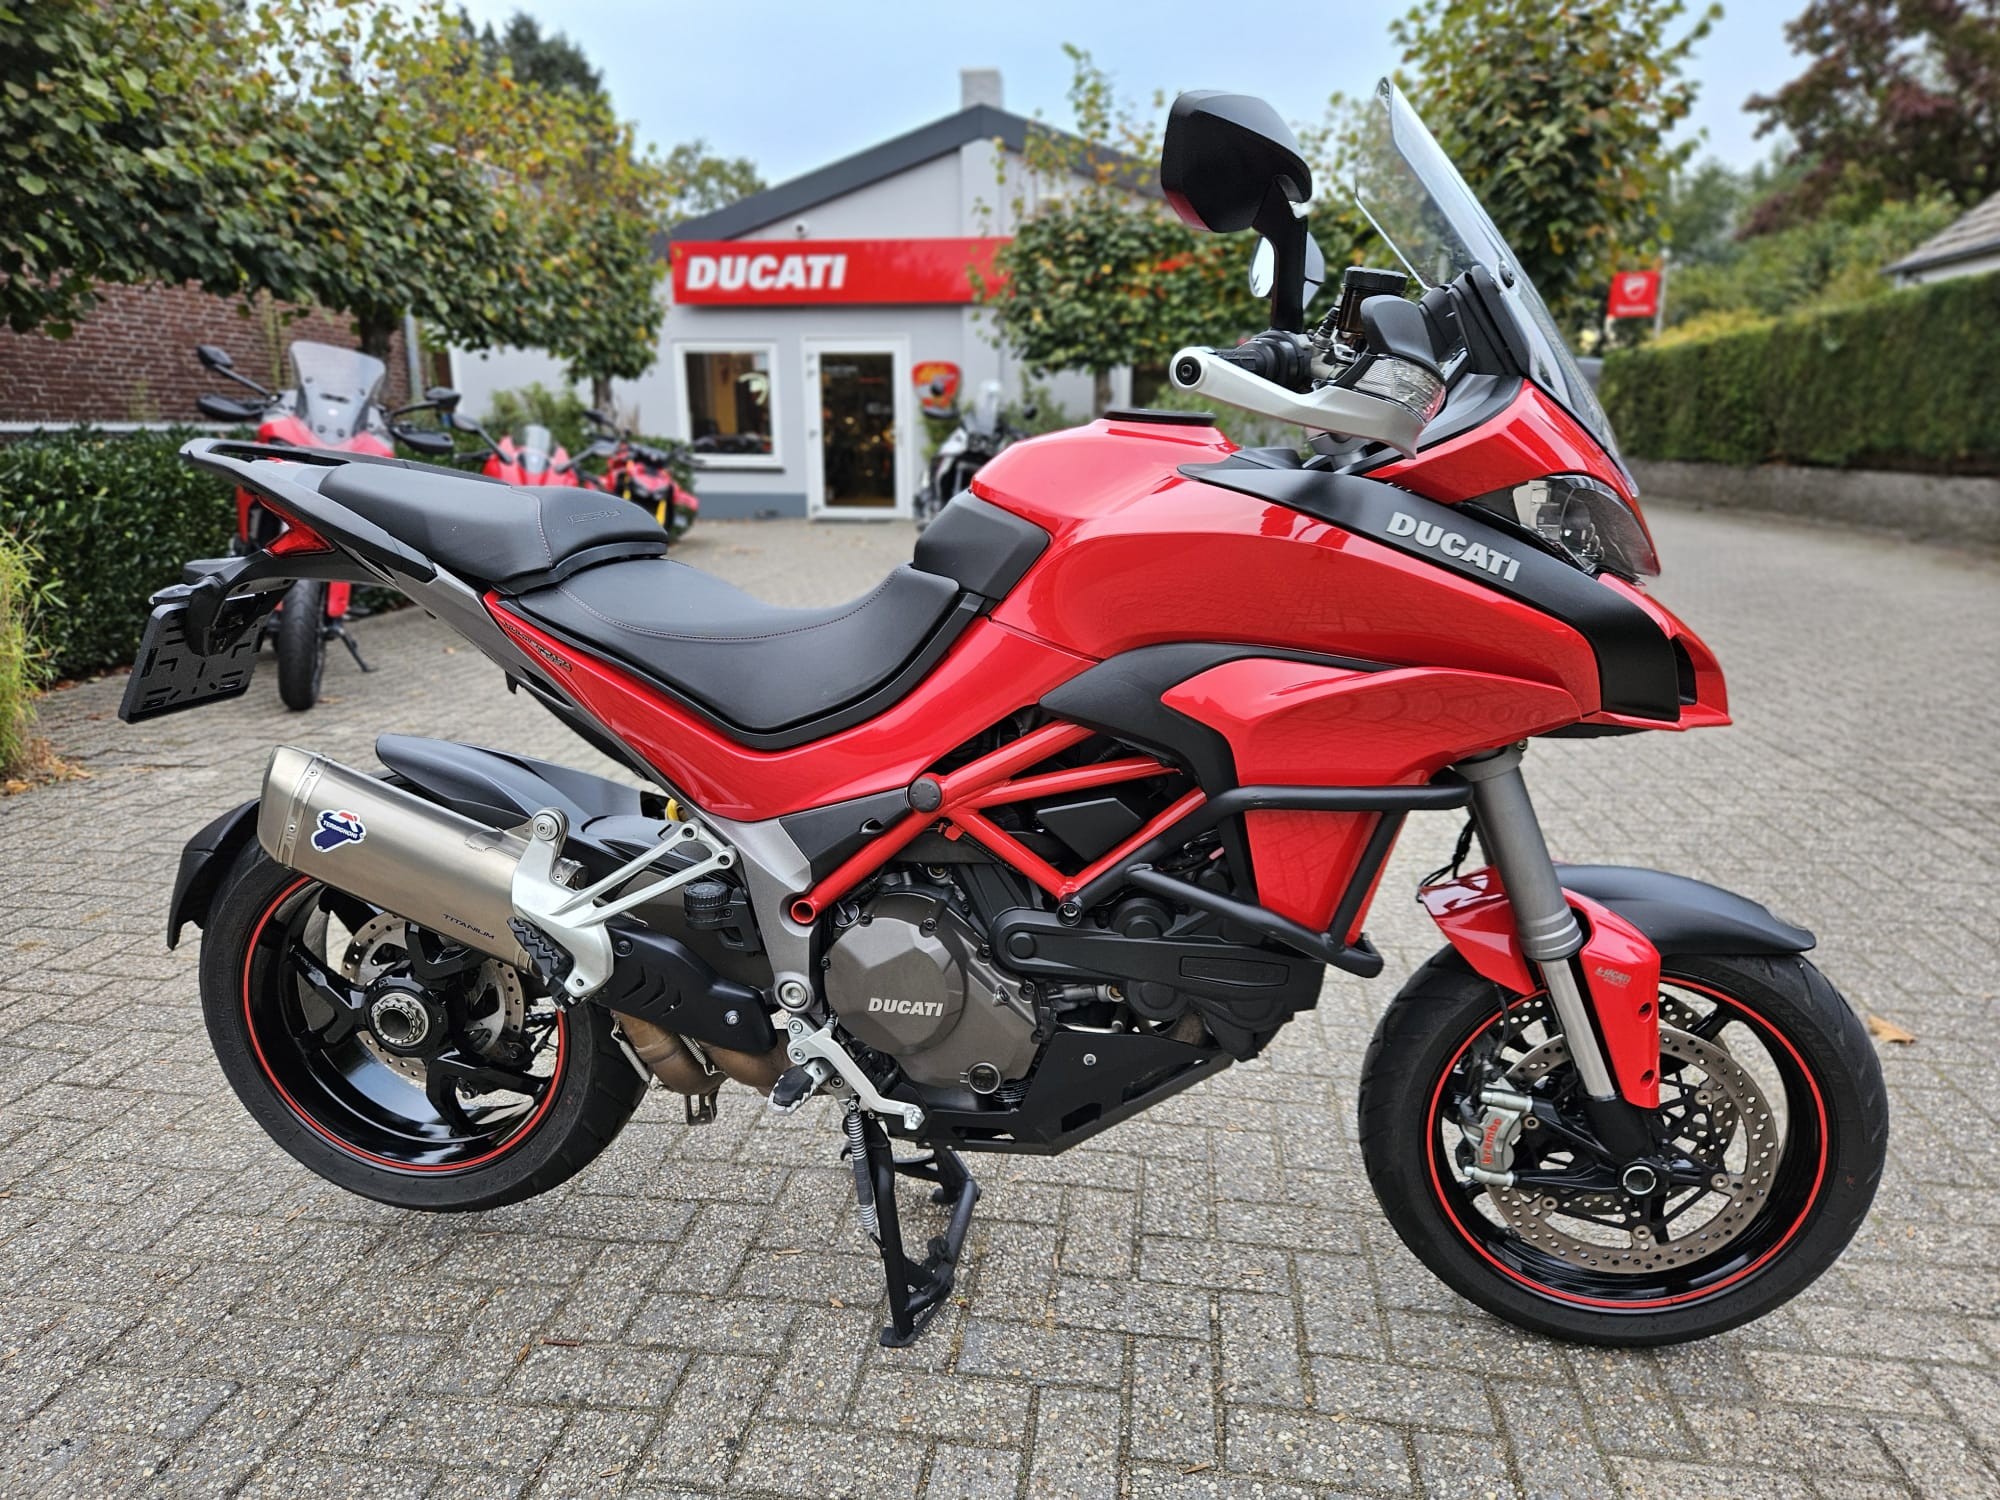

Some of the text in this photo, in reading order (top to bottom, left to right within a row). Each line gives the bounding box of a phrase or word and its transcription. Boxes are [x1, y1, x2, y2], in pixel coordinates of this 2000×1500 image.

[684, 254, 849, 292] DUCATI
[1385, 511, 1521, 582] DUCATI
[442, 913, 495, 940] TITANIUM
[867, 997, 944, 1017] DUCATI
[1481, 1118, 1502, 1165] brembo
